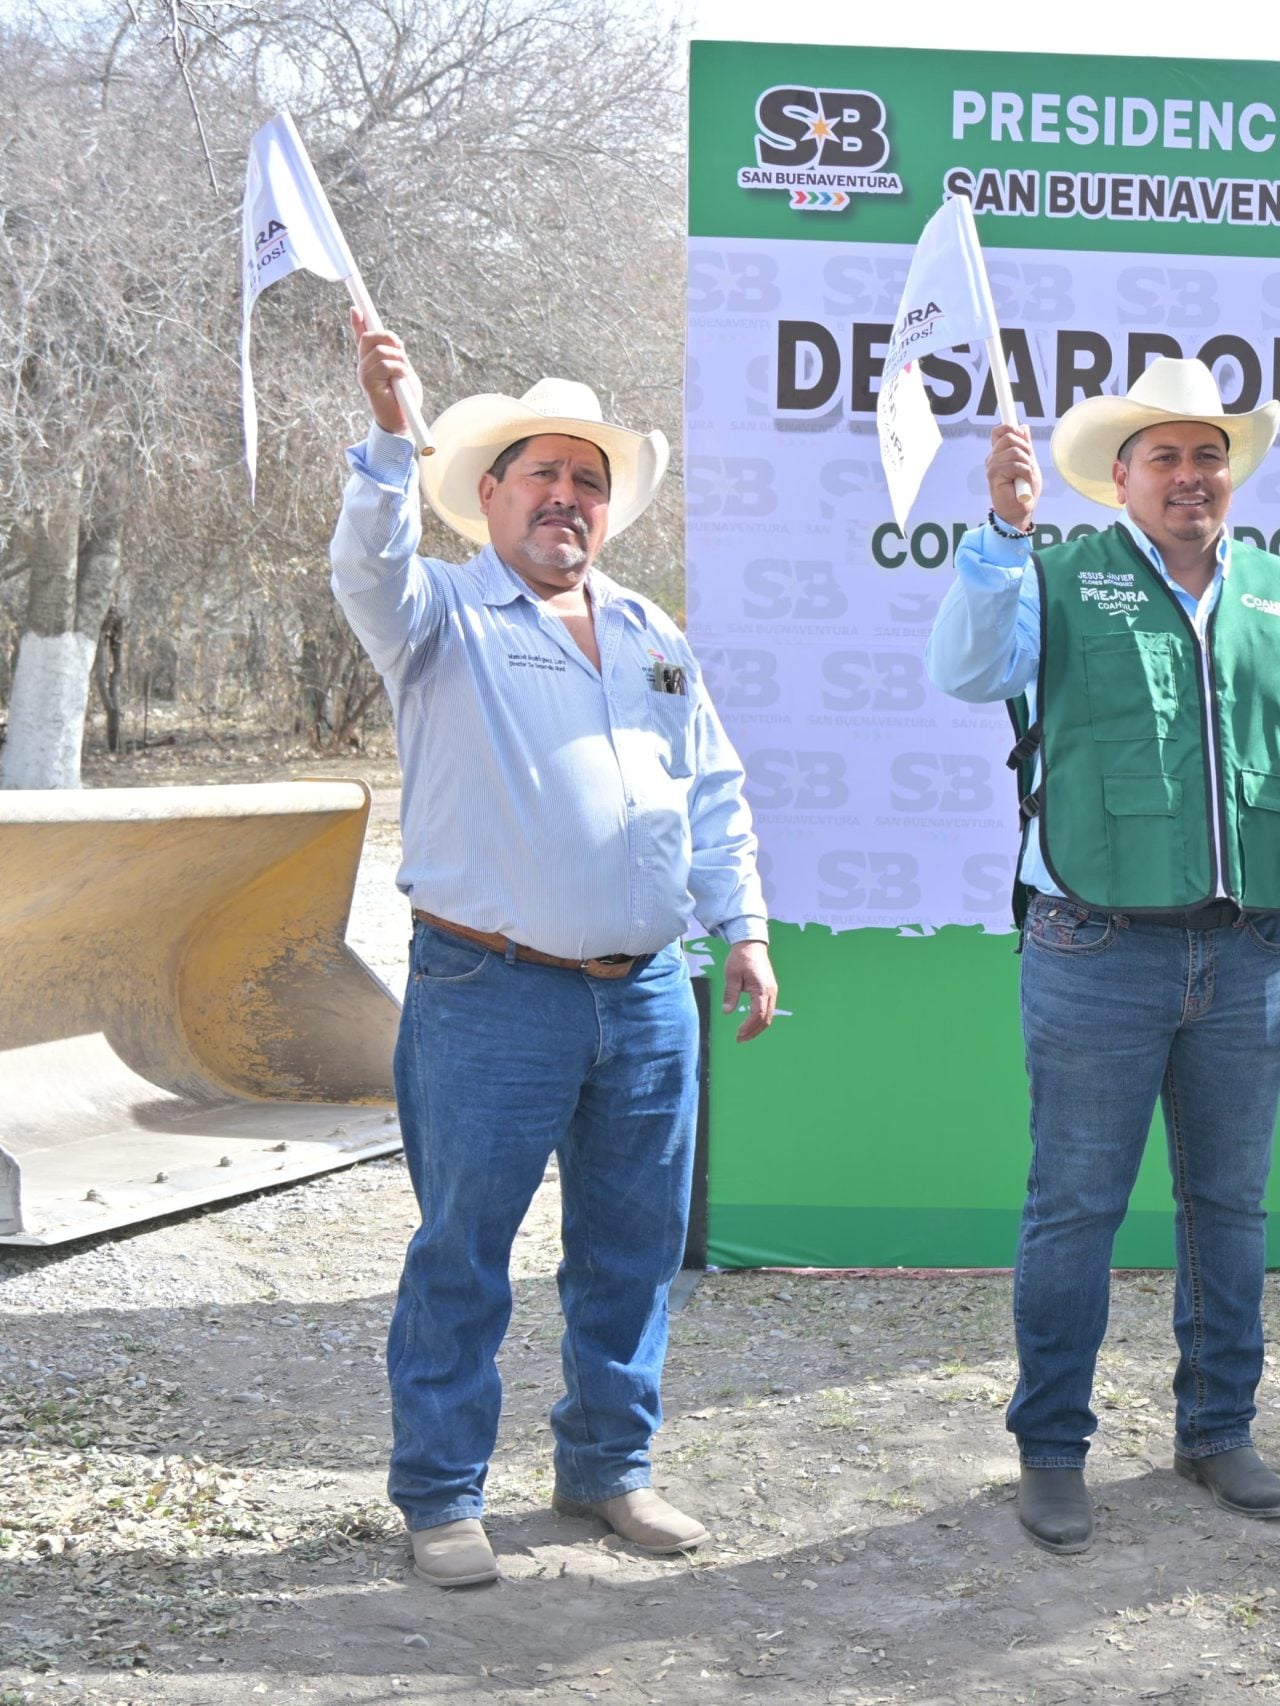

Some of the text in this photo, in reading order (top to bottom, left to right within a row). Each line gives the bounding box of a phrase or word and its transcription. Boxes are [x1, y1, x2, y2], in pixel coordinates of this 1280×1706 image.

[757, 87, 889, 168] SB
[741, 171, 898, 189] SAN BUENAVENTURA
[948, 171, 1037, 213] SAN
[1097, 600, 1140, 612] COAHUILA
